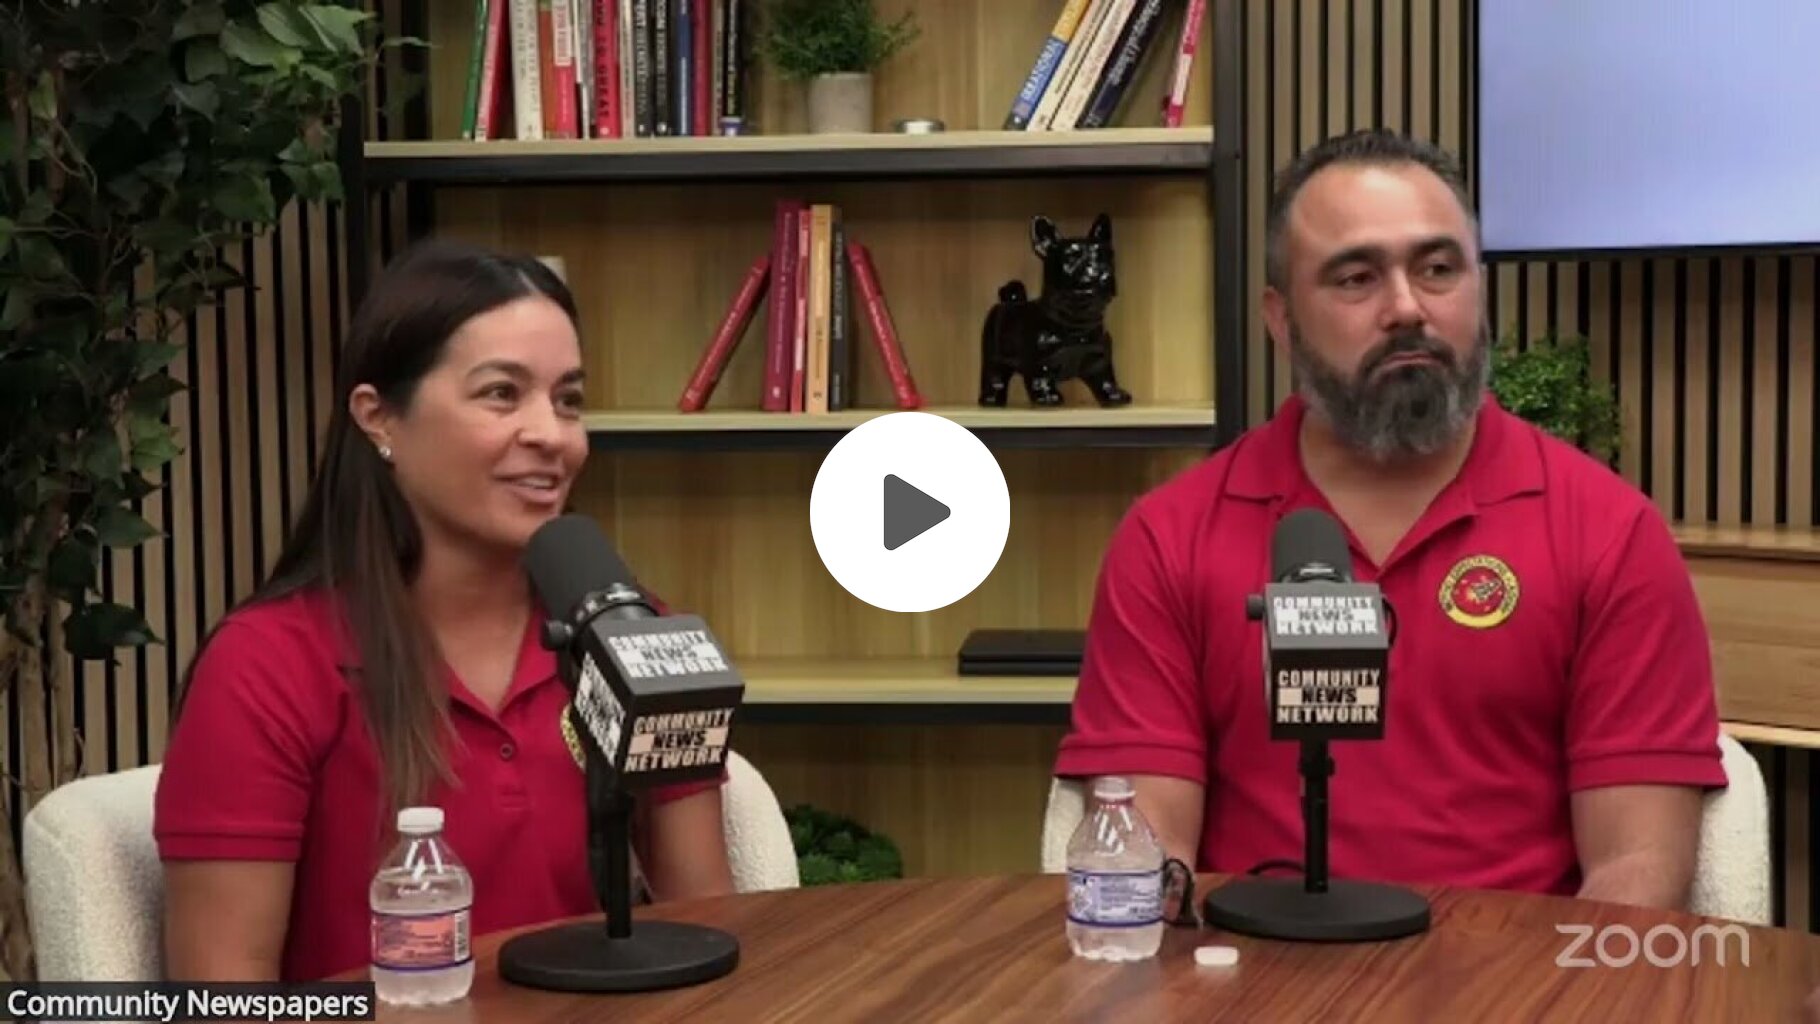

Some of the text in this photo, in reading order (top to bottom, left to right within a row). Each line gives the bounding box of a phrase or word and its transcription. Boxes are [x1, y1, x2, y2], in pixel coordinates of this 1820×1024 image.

[1273, 597, 1373, 609] COMMUNITY
[1299, 609, 1353, 621] NEWS
[1276, 621, 1377, 634] NETWORK
[640, 645, 698, 661] NEWS
[625, 658, 728, 678] NETWORK
[1278, 670, 1380, 687] COMMUNITY
[1302, 688, 1356, 703] NEWS
[634, 709, 734, 735] COMMUNITY
[1277, 706, 1378, 724] NETWORK
[652, 730, 707, 749] NEWS
[624, 747, 722, 773] NETWORK
